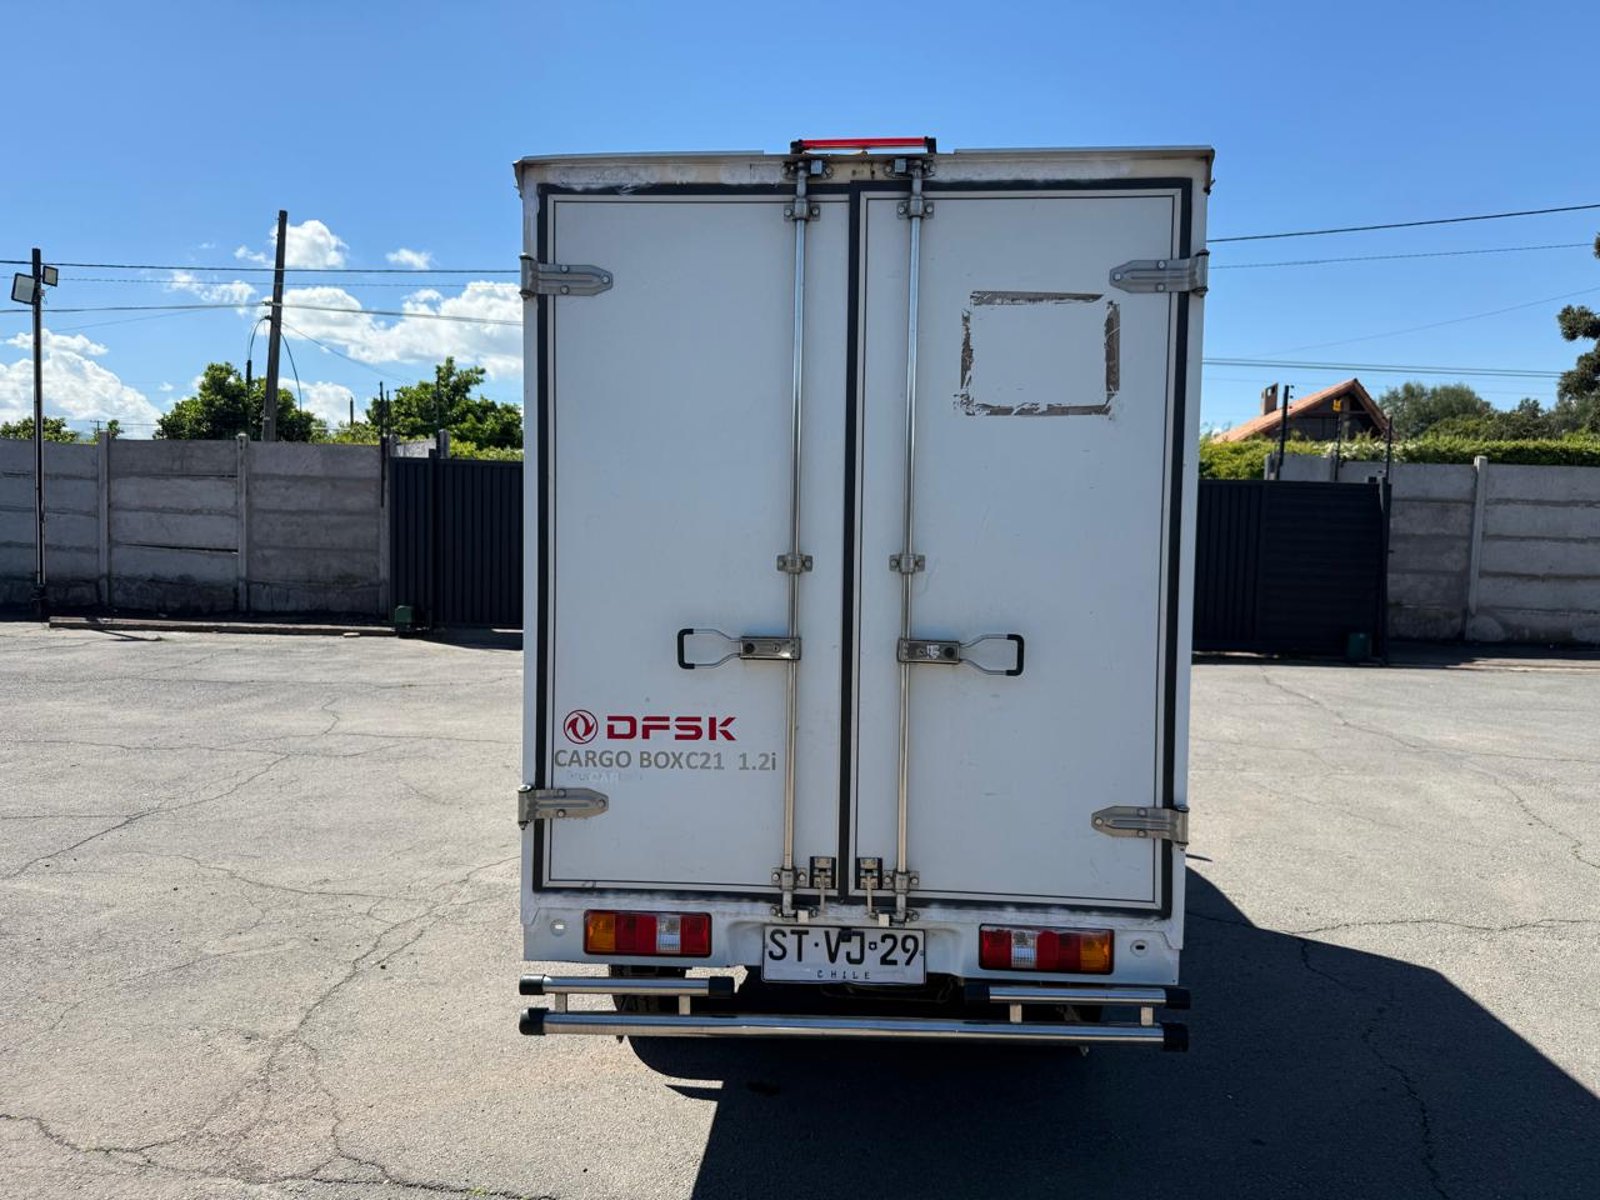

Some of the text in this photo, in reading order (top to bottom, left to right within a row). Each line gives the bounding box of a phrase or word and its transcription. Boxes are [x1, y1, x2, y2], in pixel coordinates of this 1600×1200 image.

[606, 715, 737, 741] DFSK
[554, 749, 632, 768] CARGO
[738, 752, 777, 771] 1.2i
[816, 970, 871, 980] CHILE
